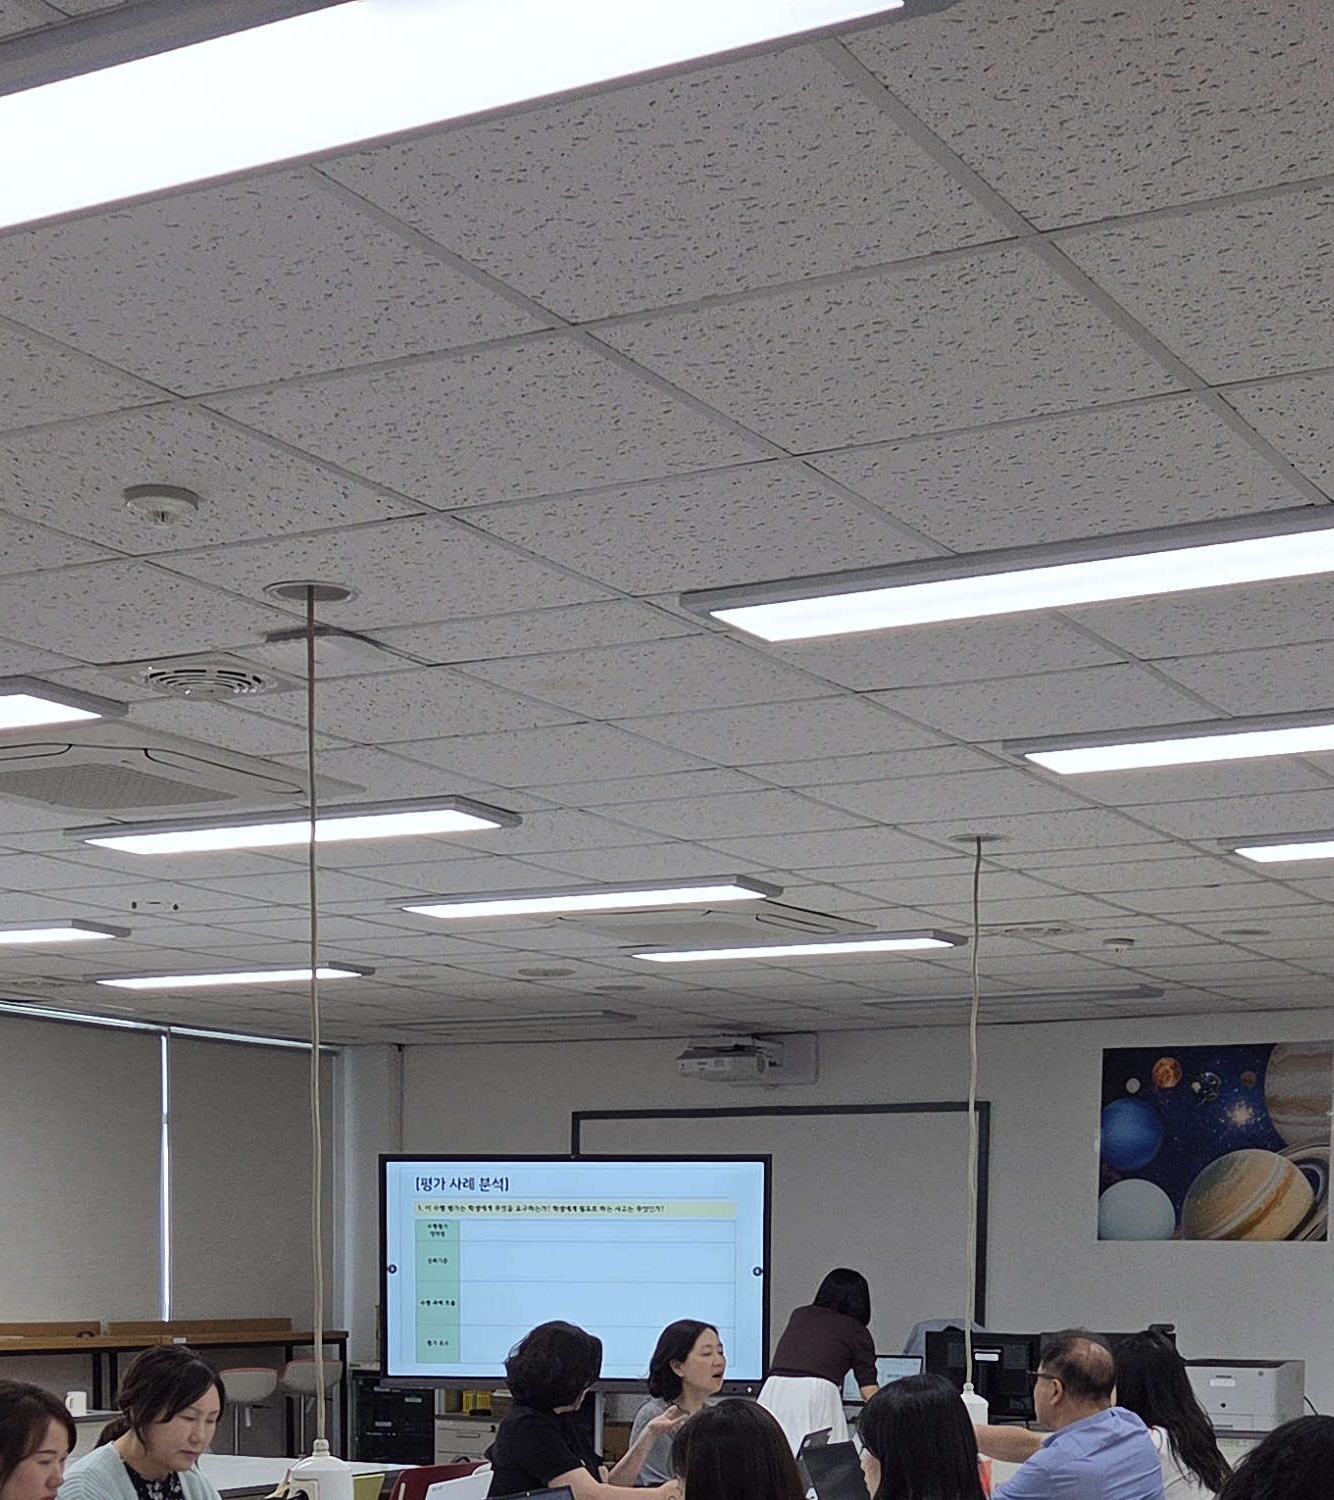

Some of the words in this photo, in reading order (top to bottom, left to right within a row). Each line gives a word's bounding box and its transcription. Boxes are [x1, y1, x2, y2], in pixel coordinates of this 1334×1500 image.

[415, 1176, 446, 1192] [평가
[449, 1176, 475, 1191] 사례
[478, 1176, 509, 1192] 분석]
